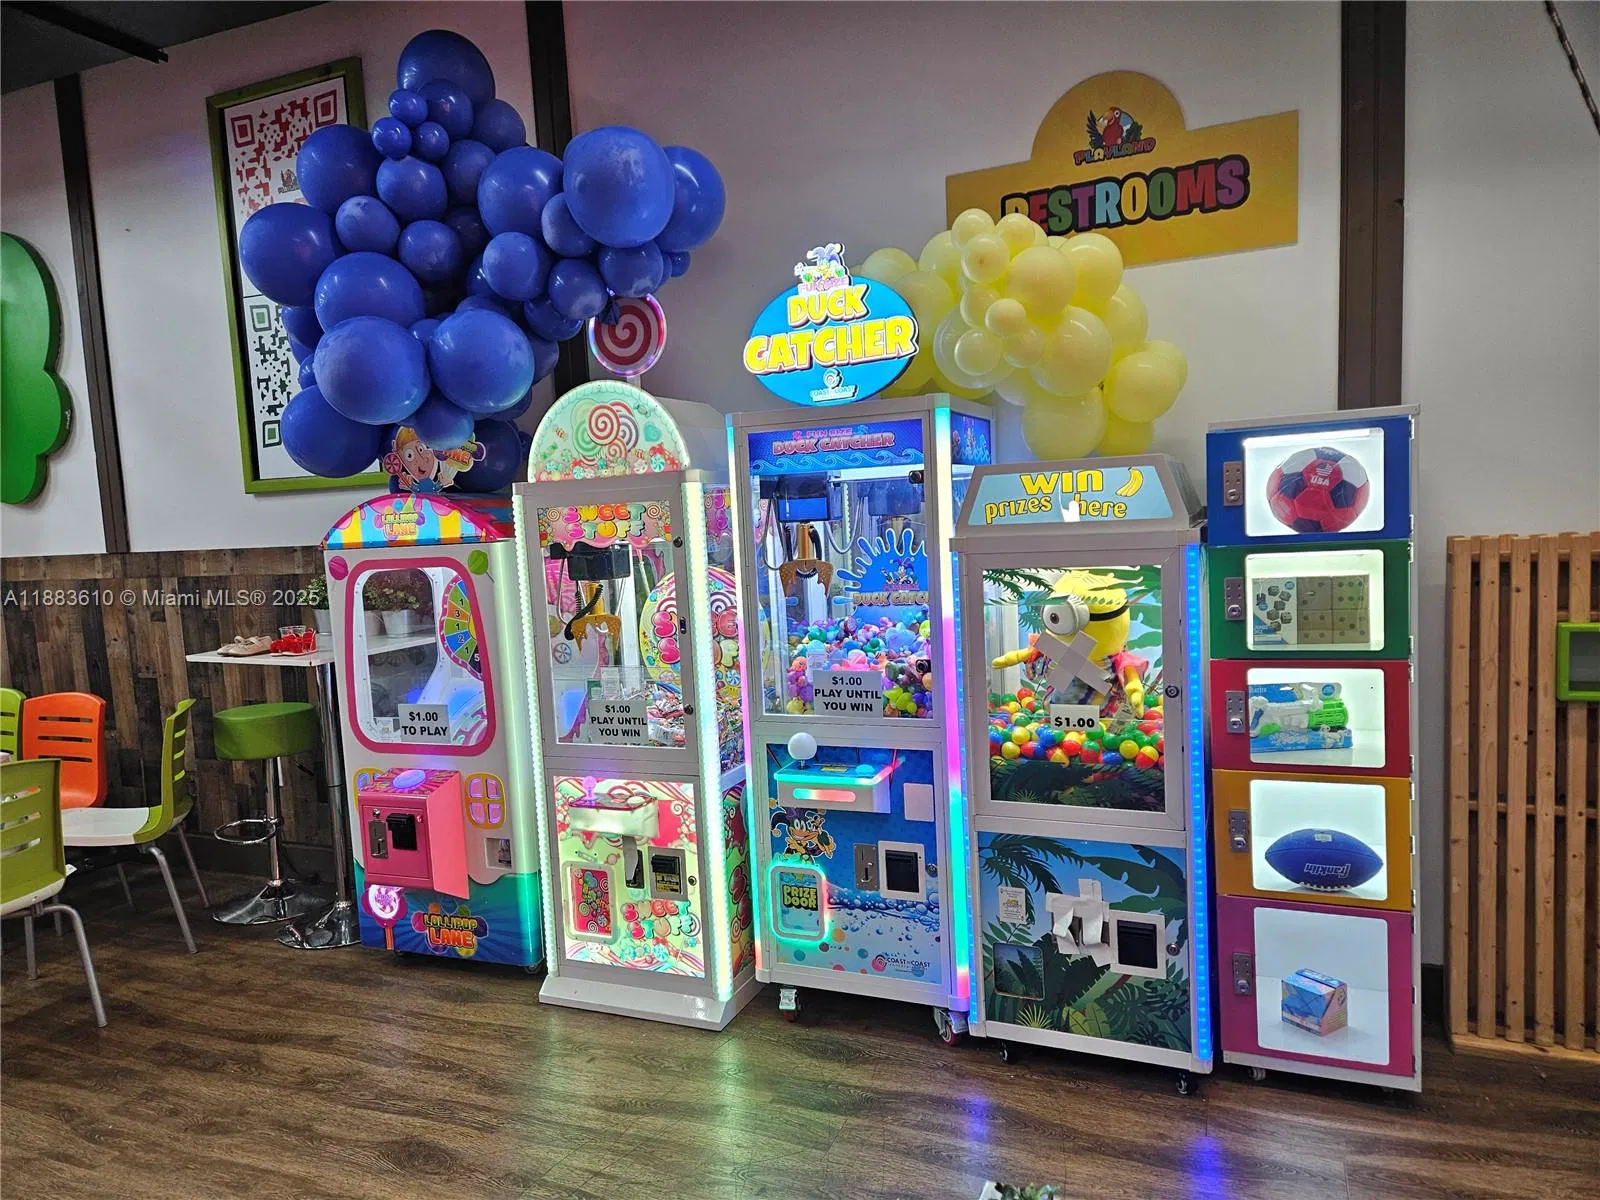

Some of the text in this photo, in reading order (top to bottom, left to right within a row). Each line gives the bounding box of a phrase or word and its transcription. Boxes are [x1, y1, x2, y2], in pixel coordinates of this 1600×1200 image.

[1073, 137, 1157, 166] PLAYLAND
[787, 284, 868, 327] DUCK
[743, 316, 919, 376] CATCHER
[772, 432, 895, 456] DUCK CATCHER
[1311, 475, 1330, 486] USA
[562, 504, 646, 523] SWEET
[985, 493, 1127, 524] prizes here
[566, 520, 645, 540] STUFF
[853, 592, 890, 606] DUCK
[458, 635, 464, 643] 2
[474, 653, 480, 661] 5
[832, 676, 862, 686] $1.00
[814, 688, 882, 699] PLAY UNTIL
[605, 704, 631, 714] $1.00
[823, 701, 873, 712] YOU WIN
[408, 711, 439, 722] $1.00
[591, 716, 647, 726] PLAY UNTIL
[1054, 716, 1095, 728] $1.00
[402, 725, 448, 736] TO PLAY
[599, 728, 641, 737] YOU WIN
[783, 885, 817, 899] PRIZE
[784, 895, 817, 908] DOOR
[620, 899, 691, 922] SWEET
[423, 913, 478, 930] LOLLIPOP
[627, 916, 694, 940] STUFF
[429, 927, 474, 949] LANE
[887, 957, 906, 965] COAST
[911, 960, 930, 968] COAST
